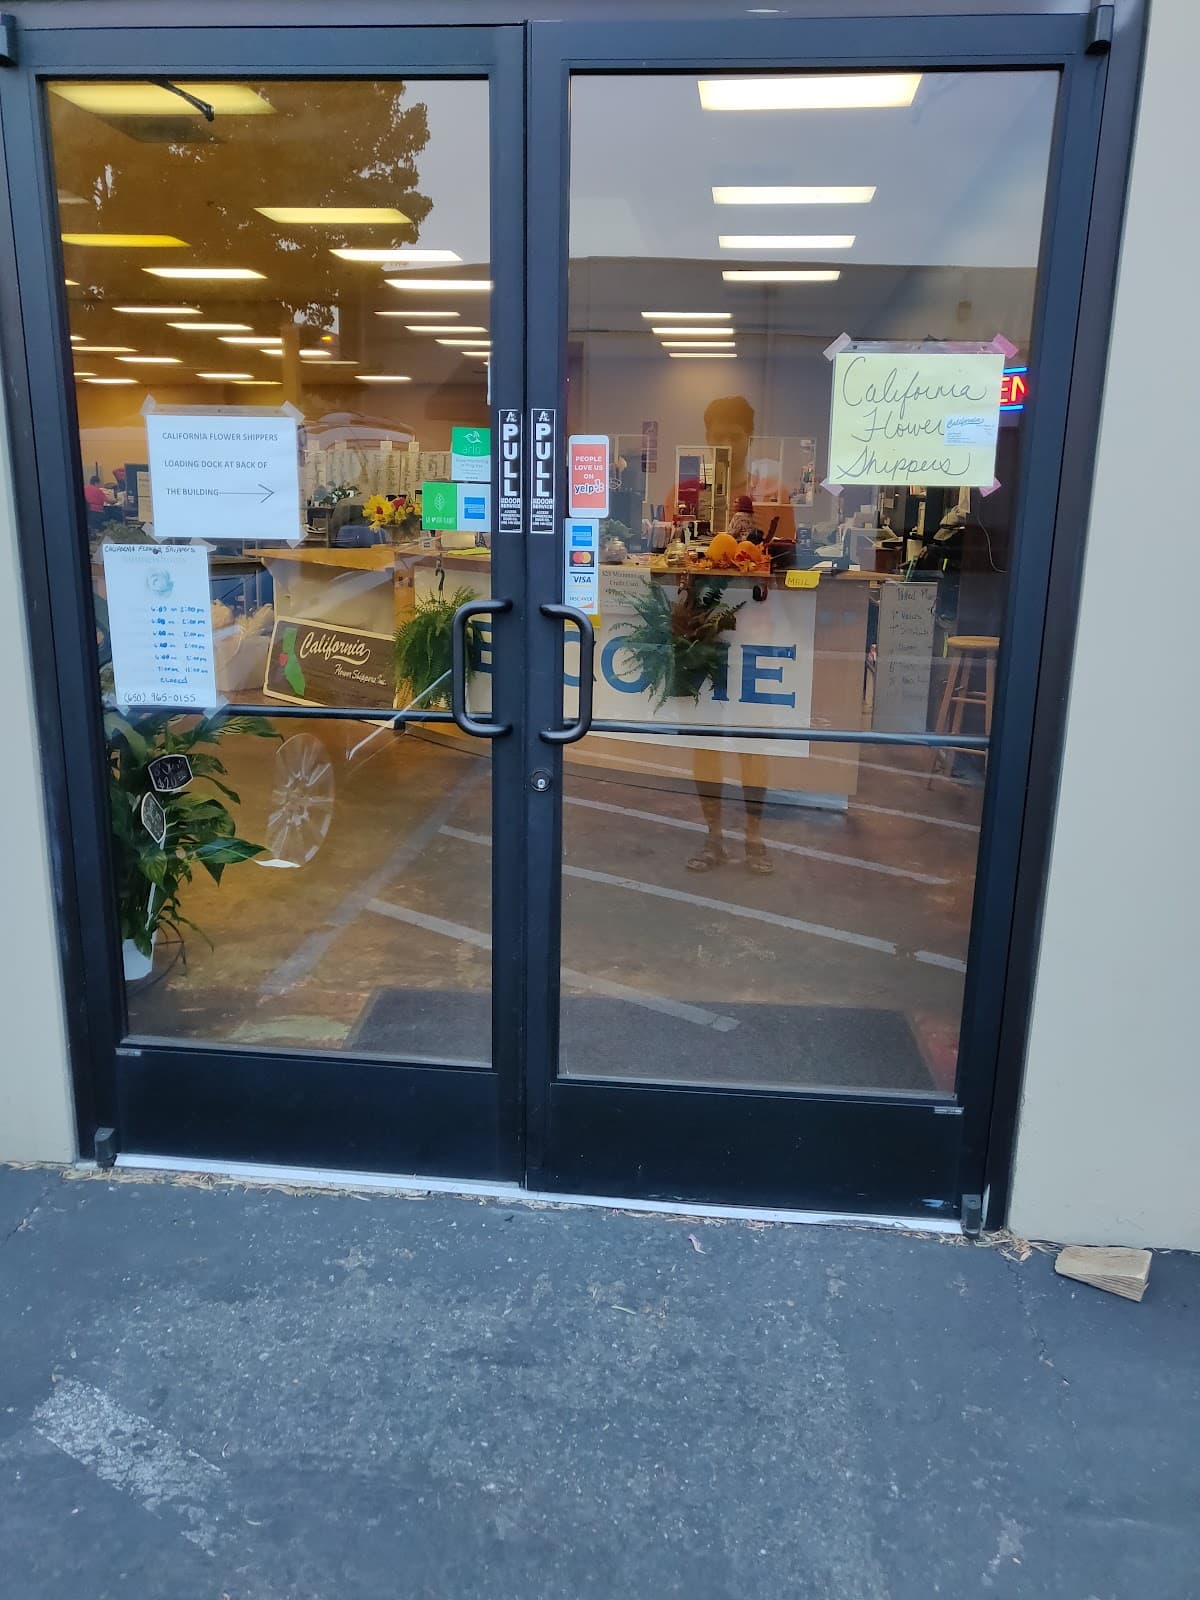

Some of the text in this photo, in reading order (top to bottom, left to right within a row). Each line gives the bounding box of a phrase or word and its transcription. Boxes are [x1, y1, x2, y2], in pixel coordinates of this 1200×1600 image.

[842, 356, 988, 420] California
[1000, 375, 1027, 403] EN
[162, 432, 278, 442] CALIFORNIA FLOWER SHIPPERS
[851, 407, 945, 442] Flower
[164, 460, 268, 469] LOADING DOCK AT BACK OF
[503, 423, 519, 497] PULL
[535, 423, 551, 497] PULL
[836, 445, 971, 481] Shippers
[166, 488, 219, 497] THE BUILDING
[574, 483, 595, 495] yelp
[300, 631, 371, 666] California
